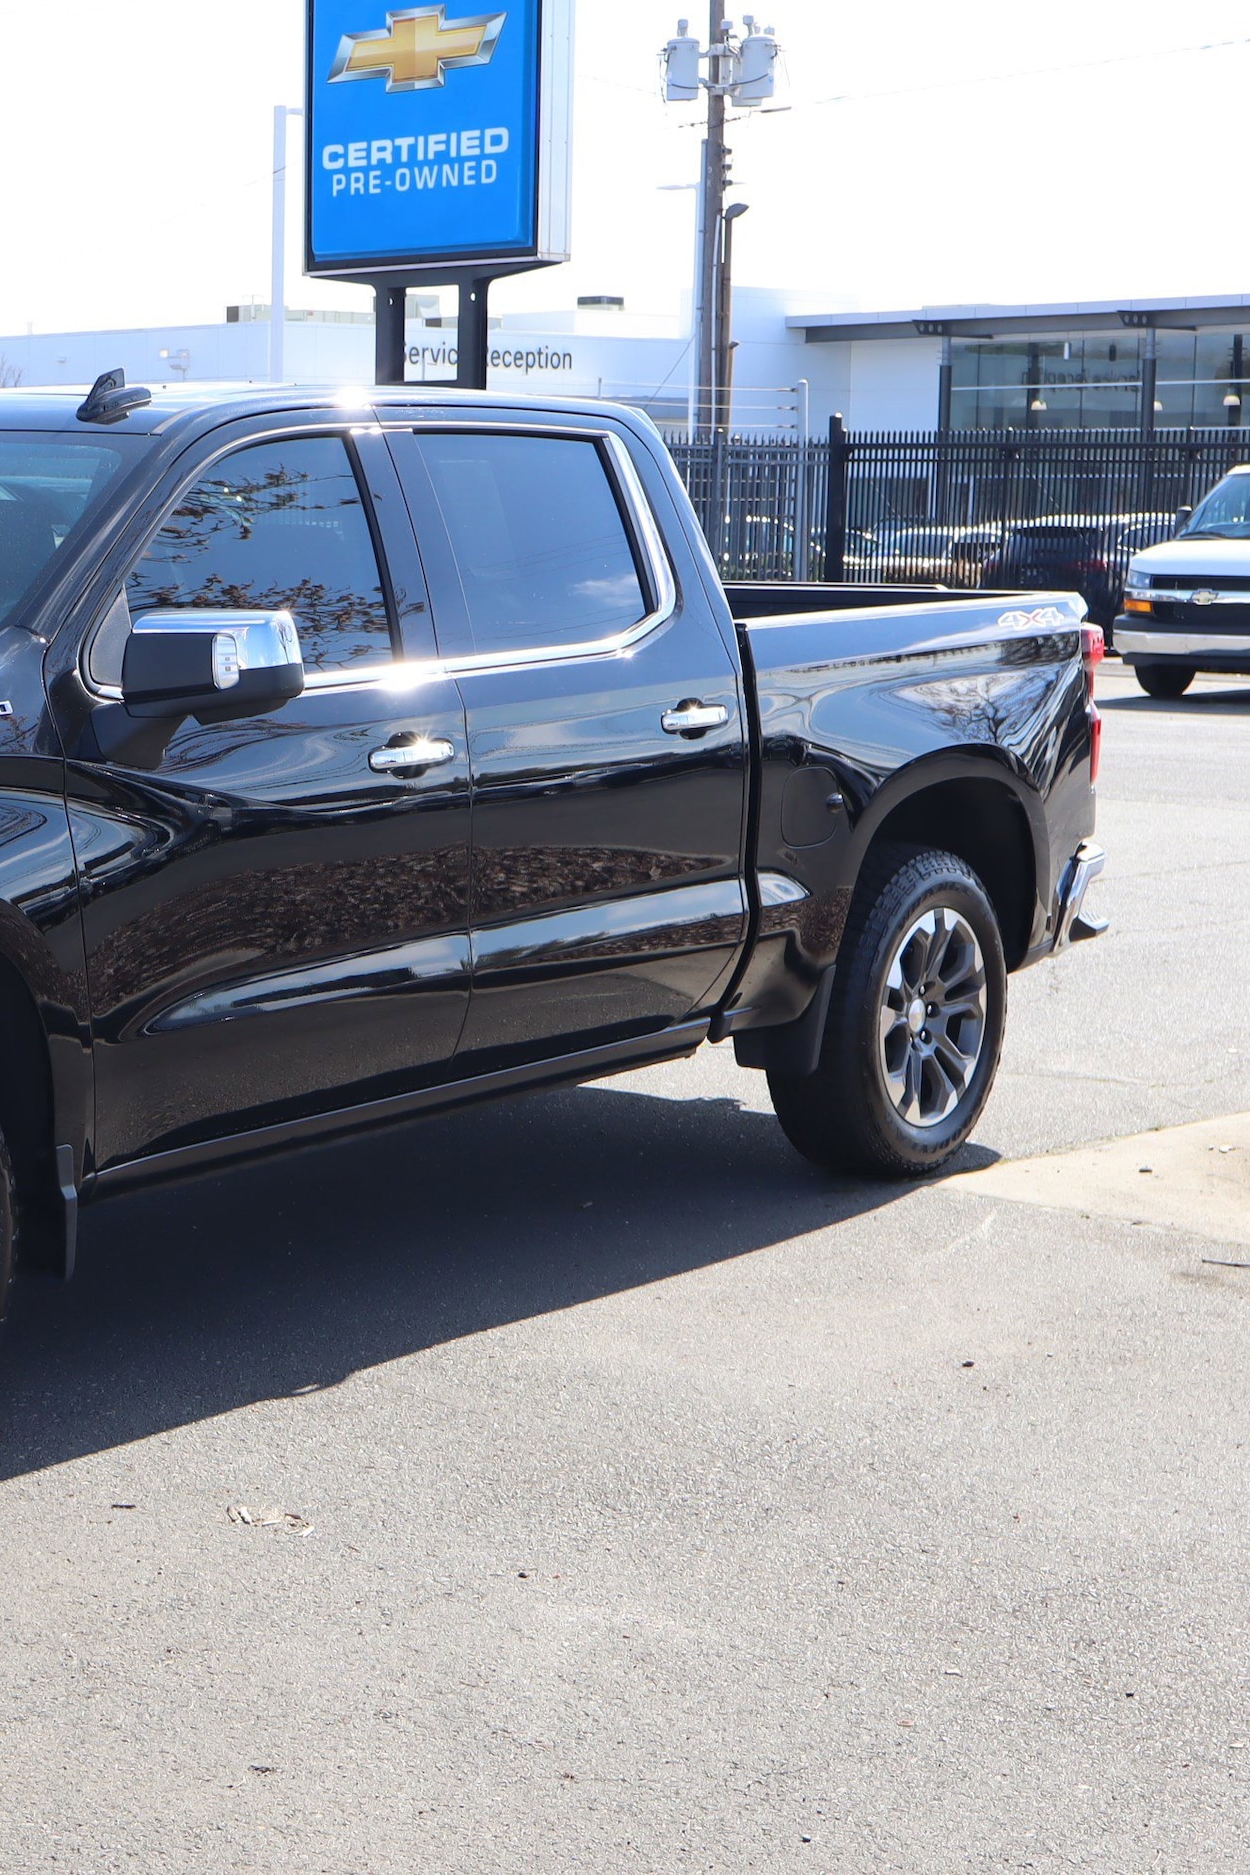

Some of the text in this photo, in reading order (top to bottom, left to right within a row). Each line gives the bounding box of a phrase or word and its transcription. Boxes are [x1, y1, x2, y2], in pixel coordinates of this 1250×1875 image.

[322, 127, 510, 170] CERTIFIED
[332, 159, 497, 197] PRE-OWNED
[404, 341, 572, 375] ervic eception
